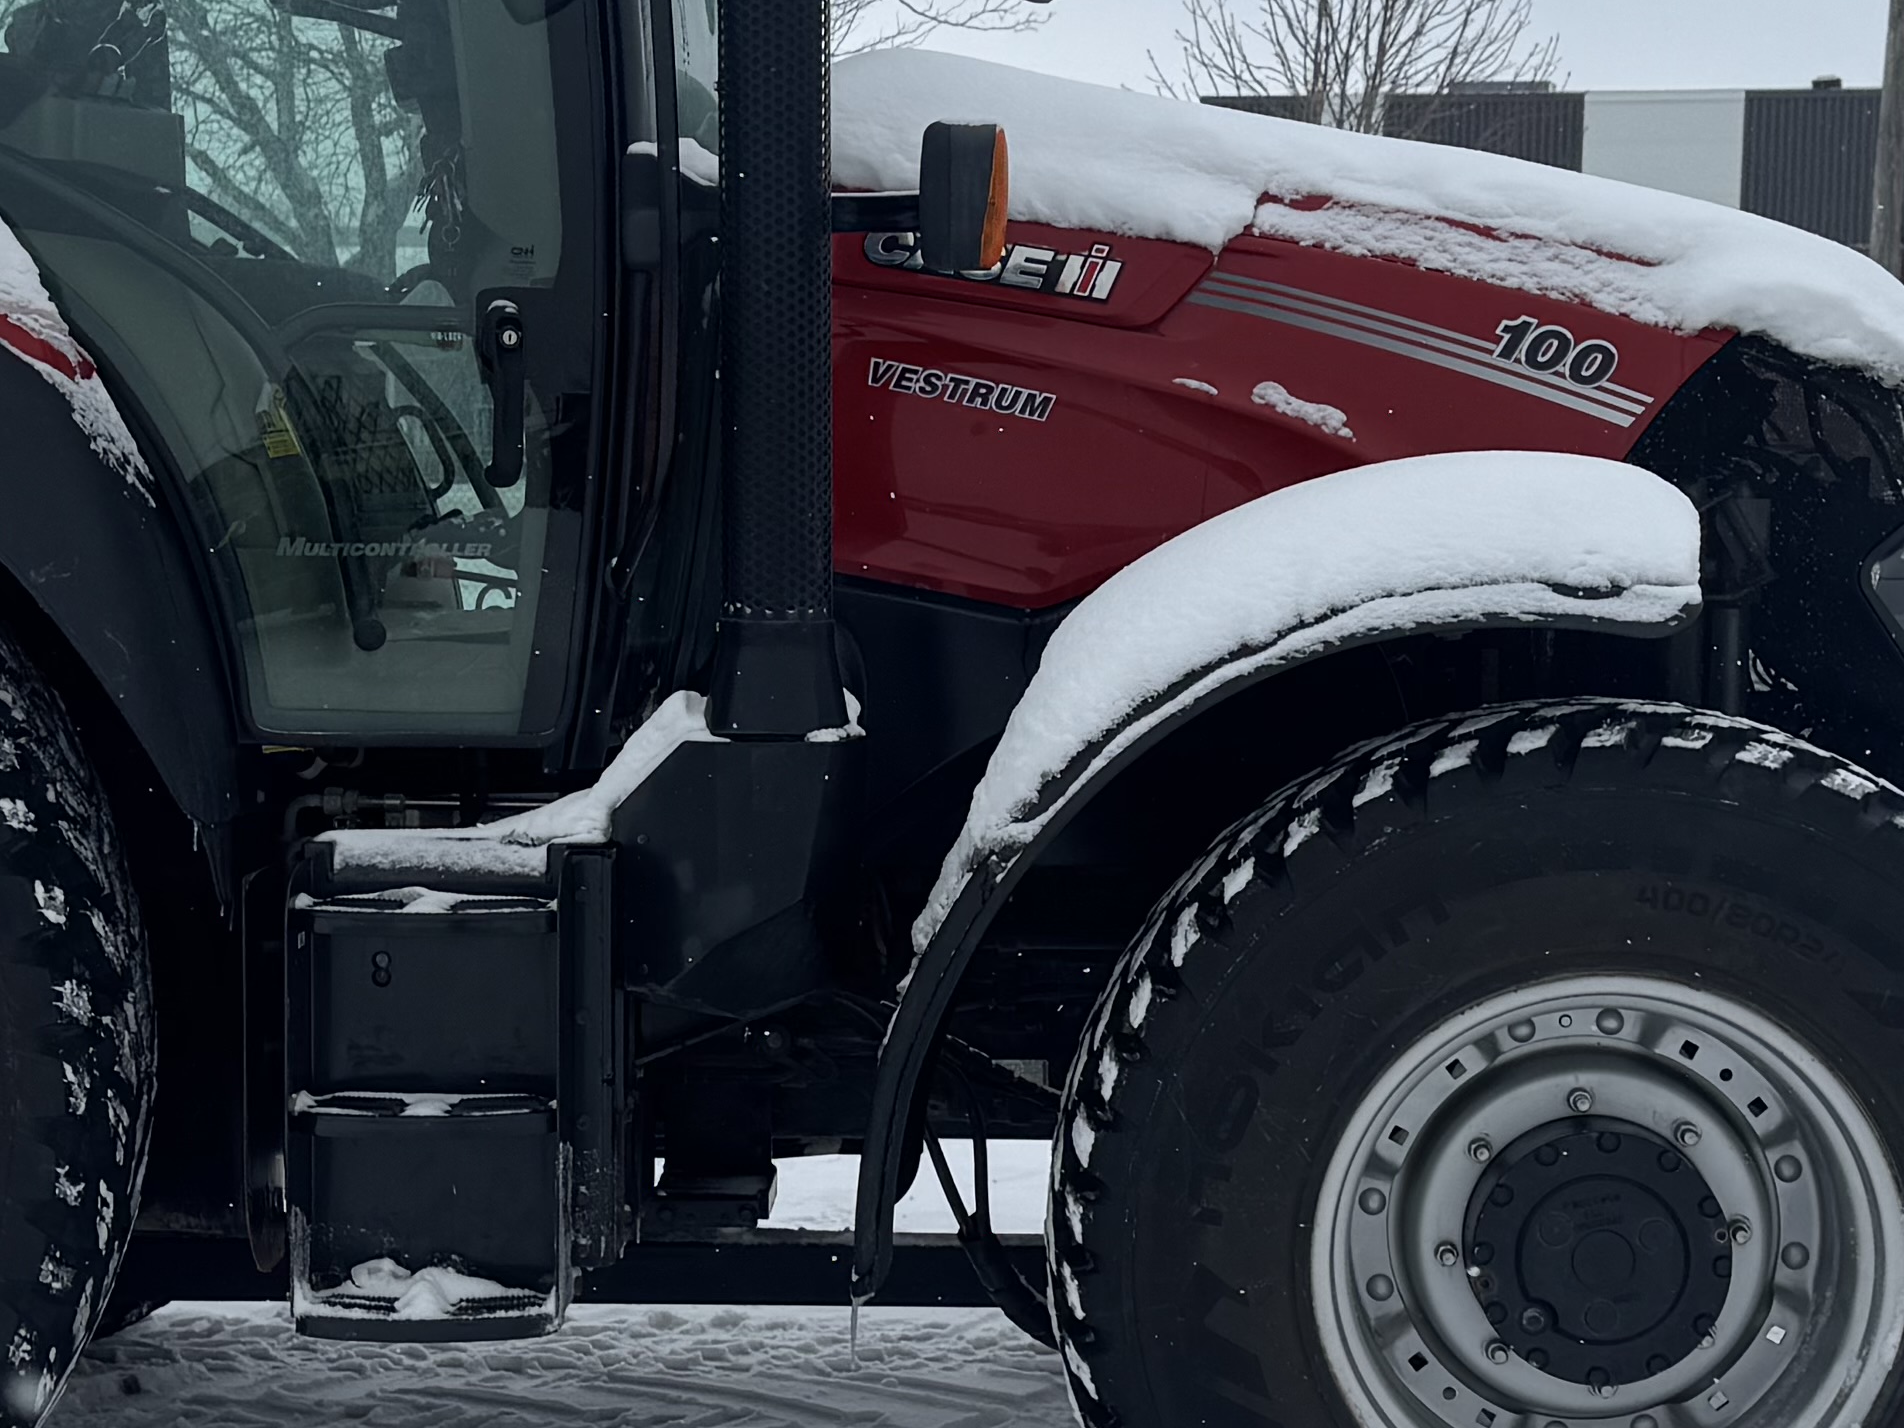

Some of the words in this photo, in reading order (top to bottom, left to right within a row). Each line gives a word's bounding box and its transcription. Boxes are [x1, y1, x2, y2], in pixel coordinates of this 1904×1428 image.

[864, 231, 1056, 290] CE
[1491, 315, 1619, 389] 100
[867, 357, 1056, 422] VESTRUM
